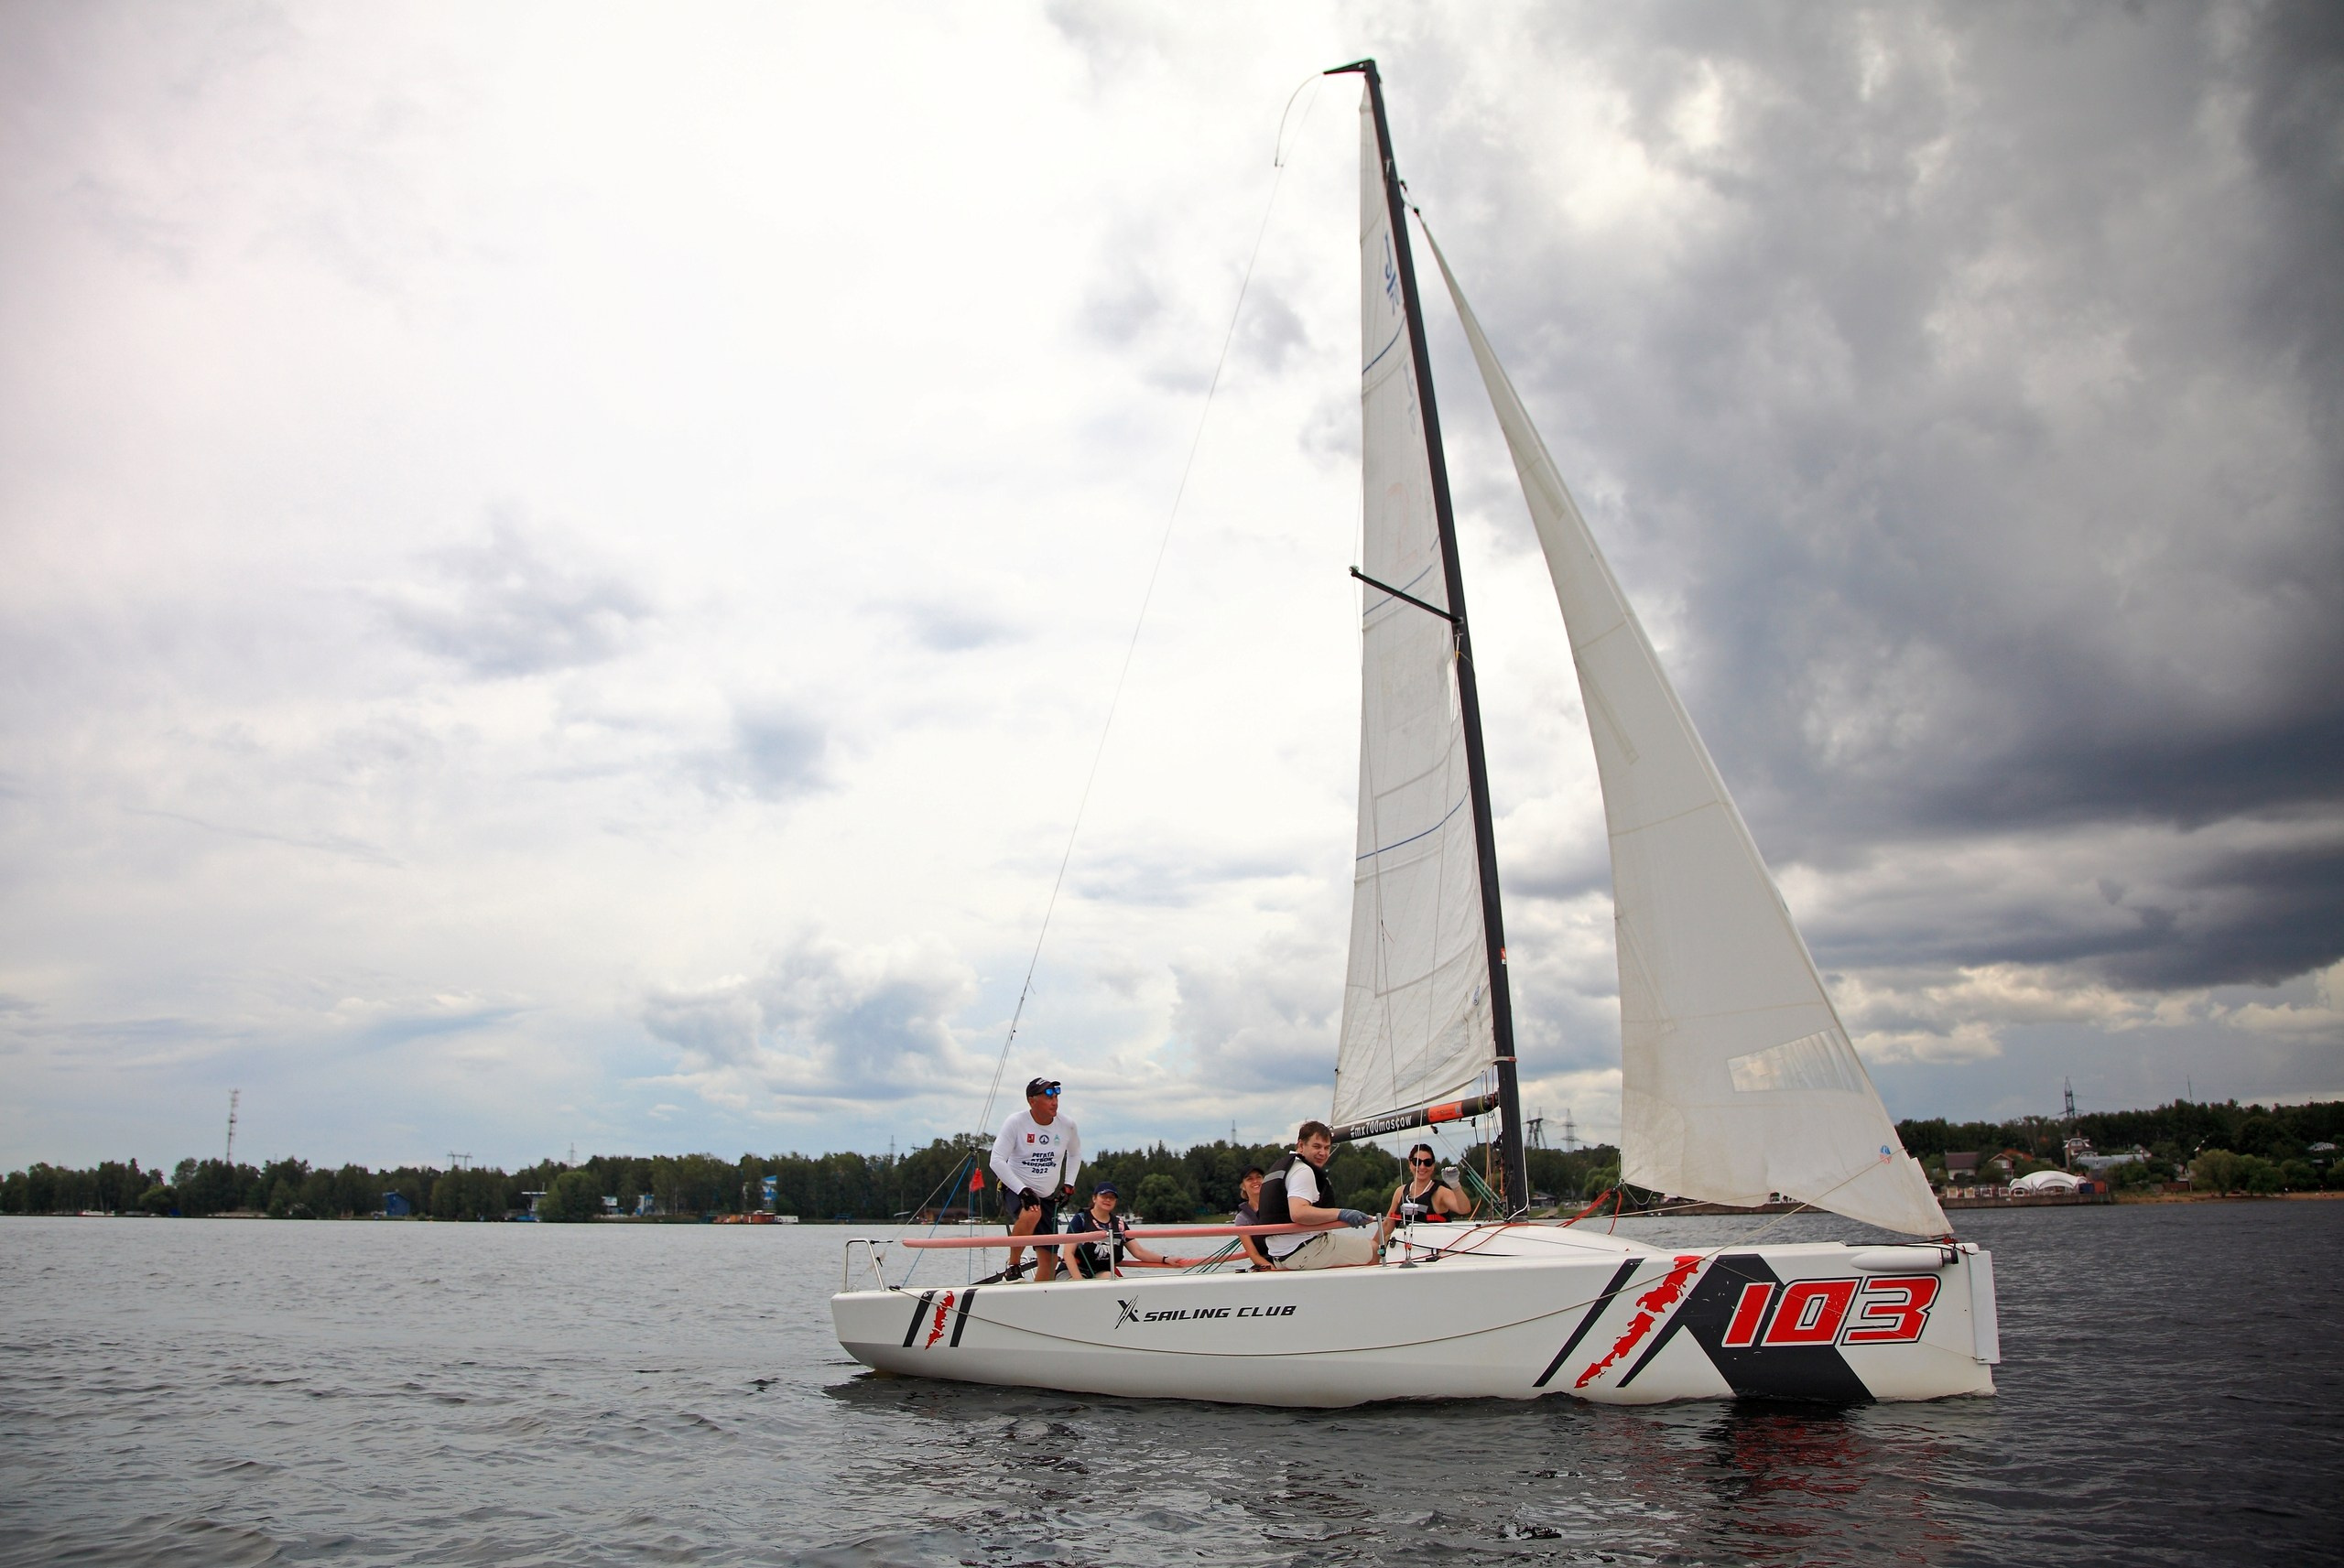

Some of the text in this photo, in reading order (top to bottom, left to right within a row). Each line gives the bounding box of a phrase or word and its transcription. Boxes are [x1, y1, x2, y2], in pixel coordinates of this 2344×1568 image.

[1143, 1307, 1232, 1322] SAILING
[1236, 1305, 1297, 1317] CLUB
[1720, 1273, 1942, 1348] 103
